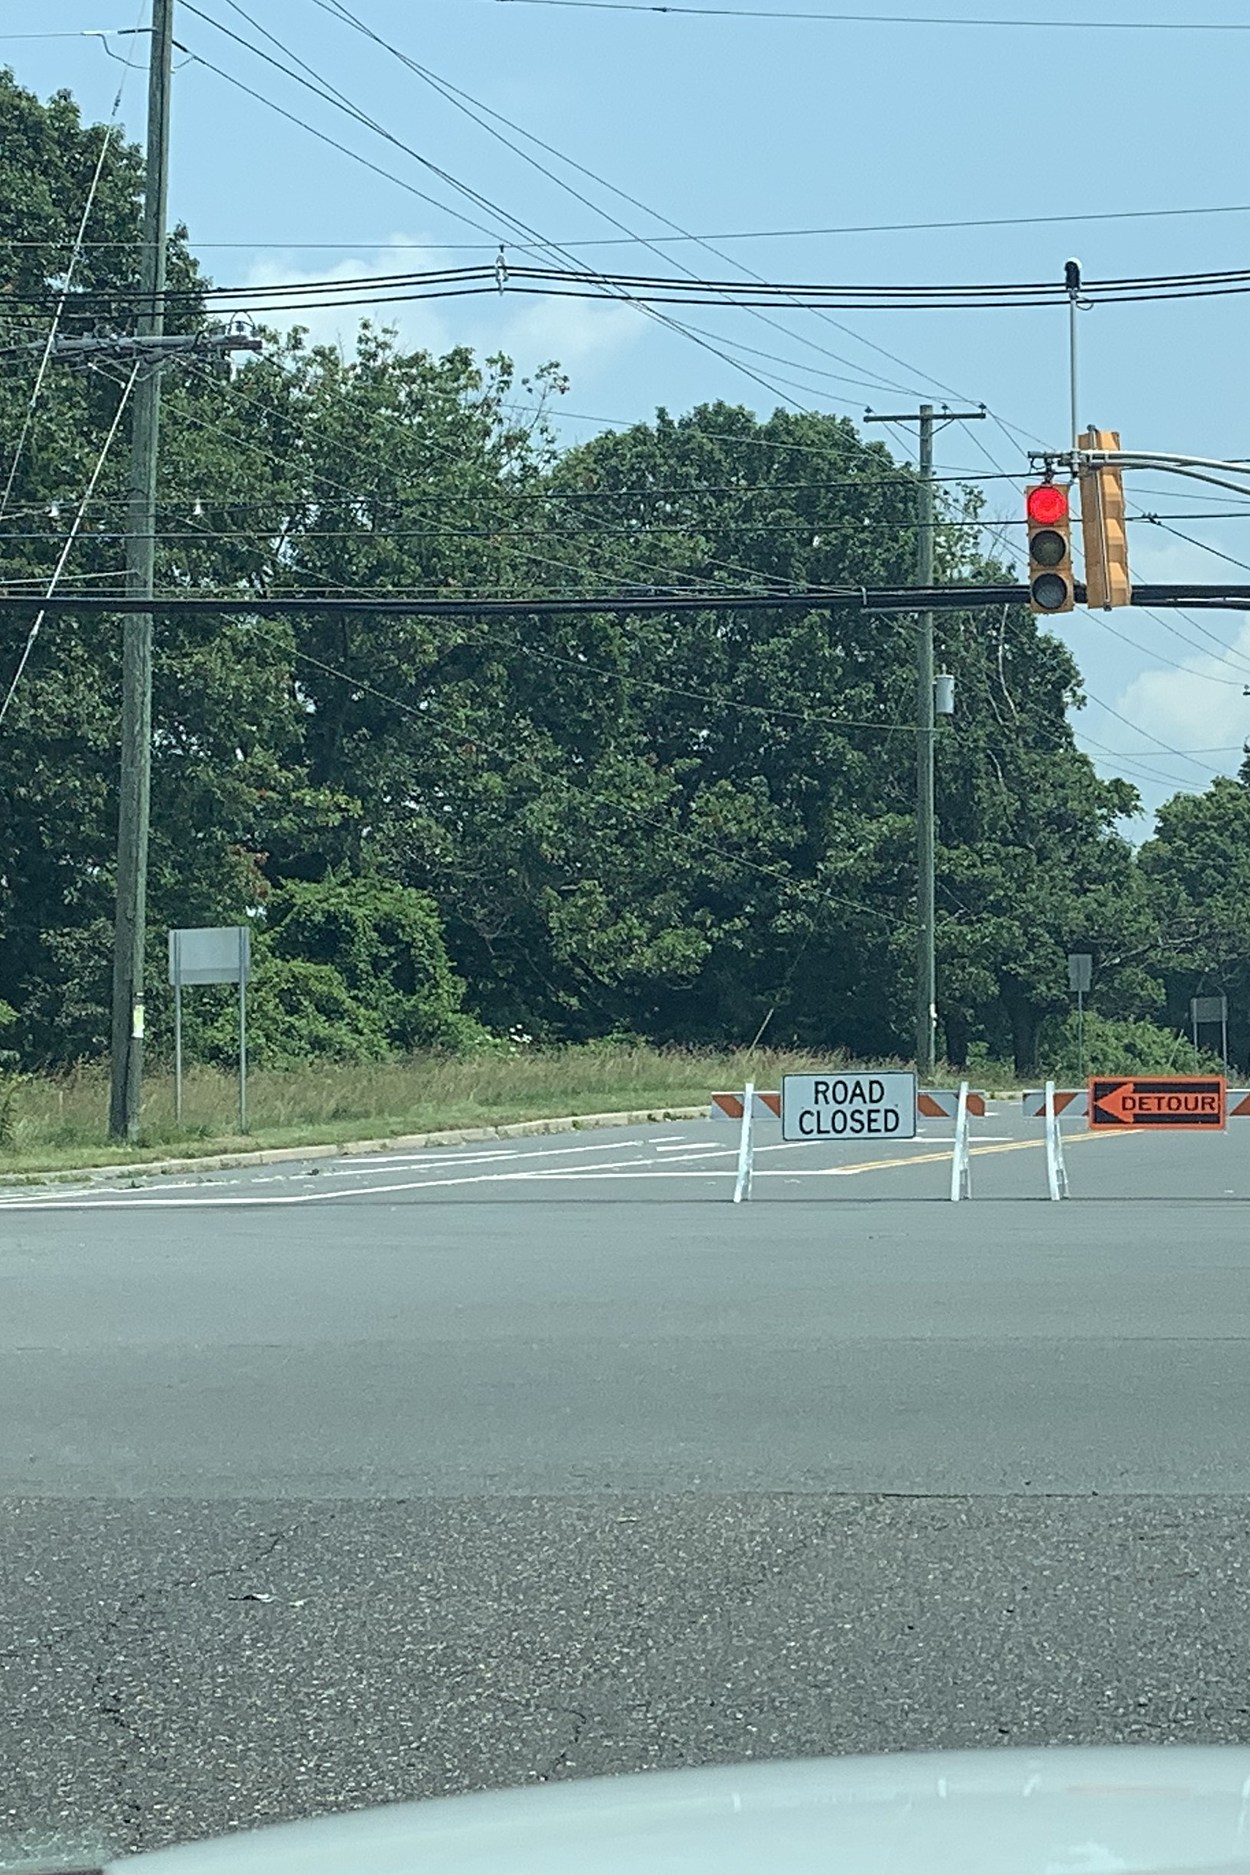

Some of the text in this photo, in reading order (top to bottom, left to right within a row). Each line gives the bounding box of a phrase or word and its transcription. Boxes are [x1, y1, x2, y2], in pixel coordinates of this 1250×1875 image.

[814, 1080, 885, 1105] ROAD
[1121, 1095, 1217, 1112] DETOUR
[799, 1108, 900, 1135] CLOSED
